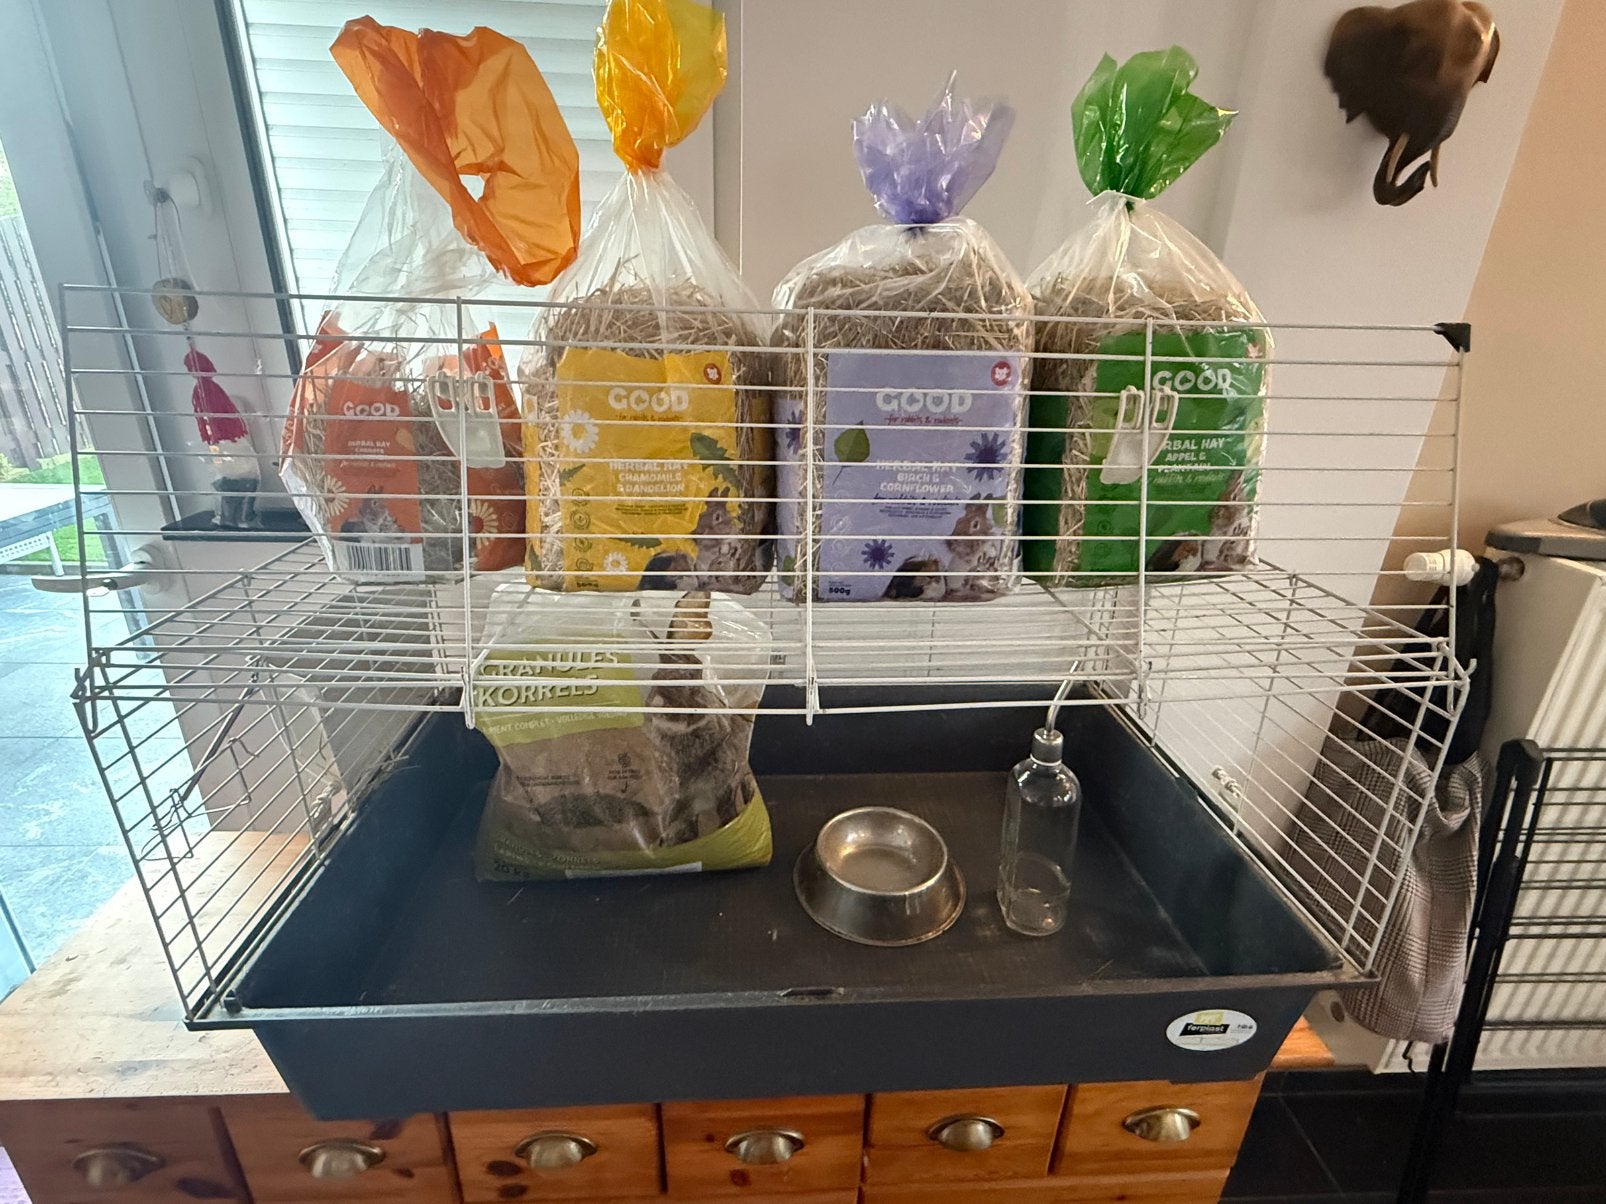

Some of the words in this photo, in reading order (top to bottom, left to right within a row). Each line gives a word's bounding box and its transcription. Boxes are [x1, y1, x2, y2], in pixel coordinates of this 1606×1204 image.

[1152, 369, 1232, 391] GOOD
[607, 386, 689, 413] GOOD
[876, 387, 973, 413] GOOD
[343, 401, 400, 418] GOOD
[1163, 439, 1198, 450] RBAL
[1201, 437, 1225, 449] HAY
[1165, 452, 1197, 462] APPEL
[609, 461, 661, 471] HERBAL
[618, 472, 682, 482] CHAMOMILE
[896, 472, 930, 483] BIRCH
[626, 482, 685, 494] DANDELION
[880, 481, 954, 494] CORNFLOWER
[829, 587, 851, 596] 500g
[480, 650, 618, 677] GRANULES
[478, 674, 599, 708] KORRELS
[1187, 1024, 1225, 1034] ferplast
